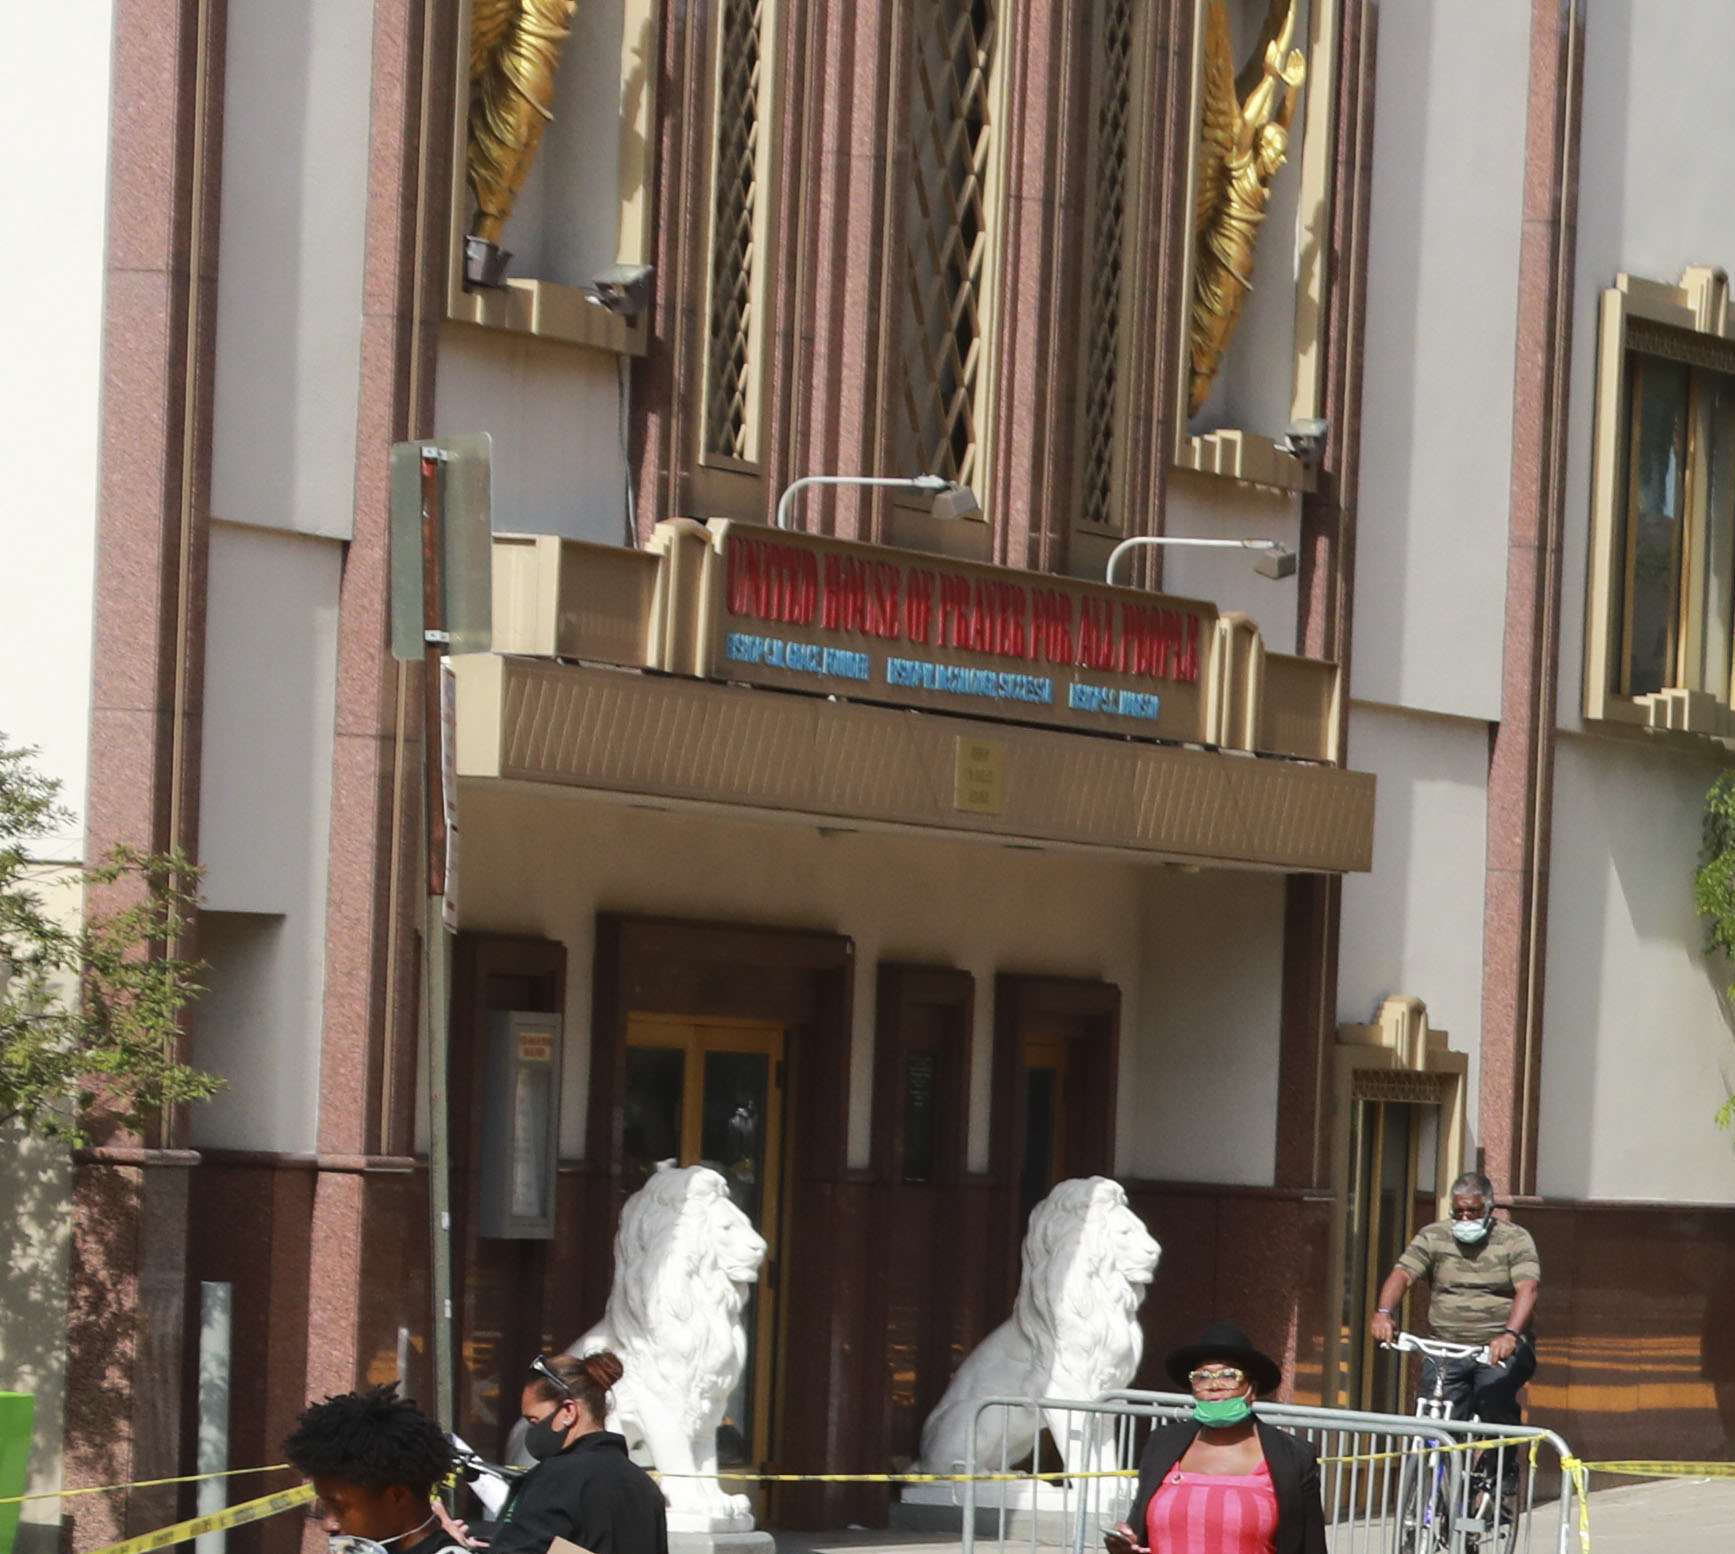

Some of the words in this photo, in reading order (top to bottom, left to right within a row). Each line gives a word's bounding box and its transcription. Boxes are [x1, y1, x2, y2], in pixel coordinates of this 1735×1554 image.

[727, 536, 818, 625] UNITED
[821, 553, 900, 640] HOUSE
[905, 565, 934, 645] OF
[937, 570, 1027, 658] PRAYER
[1029, 587, 1074, 666] FOR
[1076, 594, 1118, 673] ALL
[1120, 601, 1199, 682] PEOPLE
